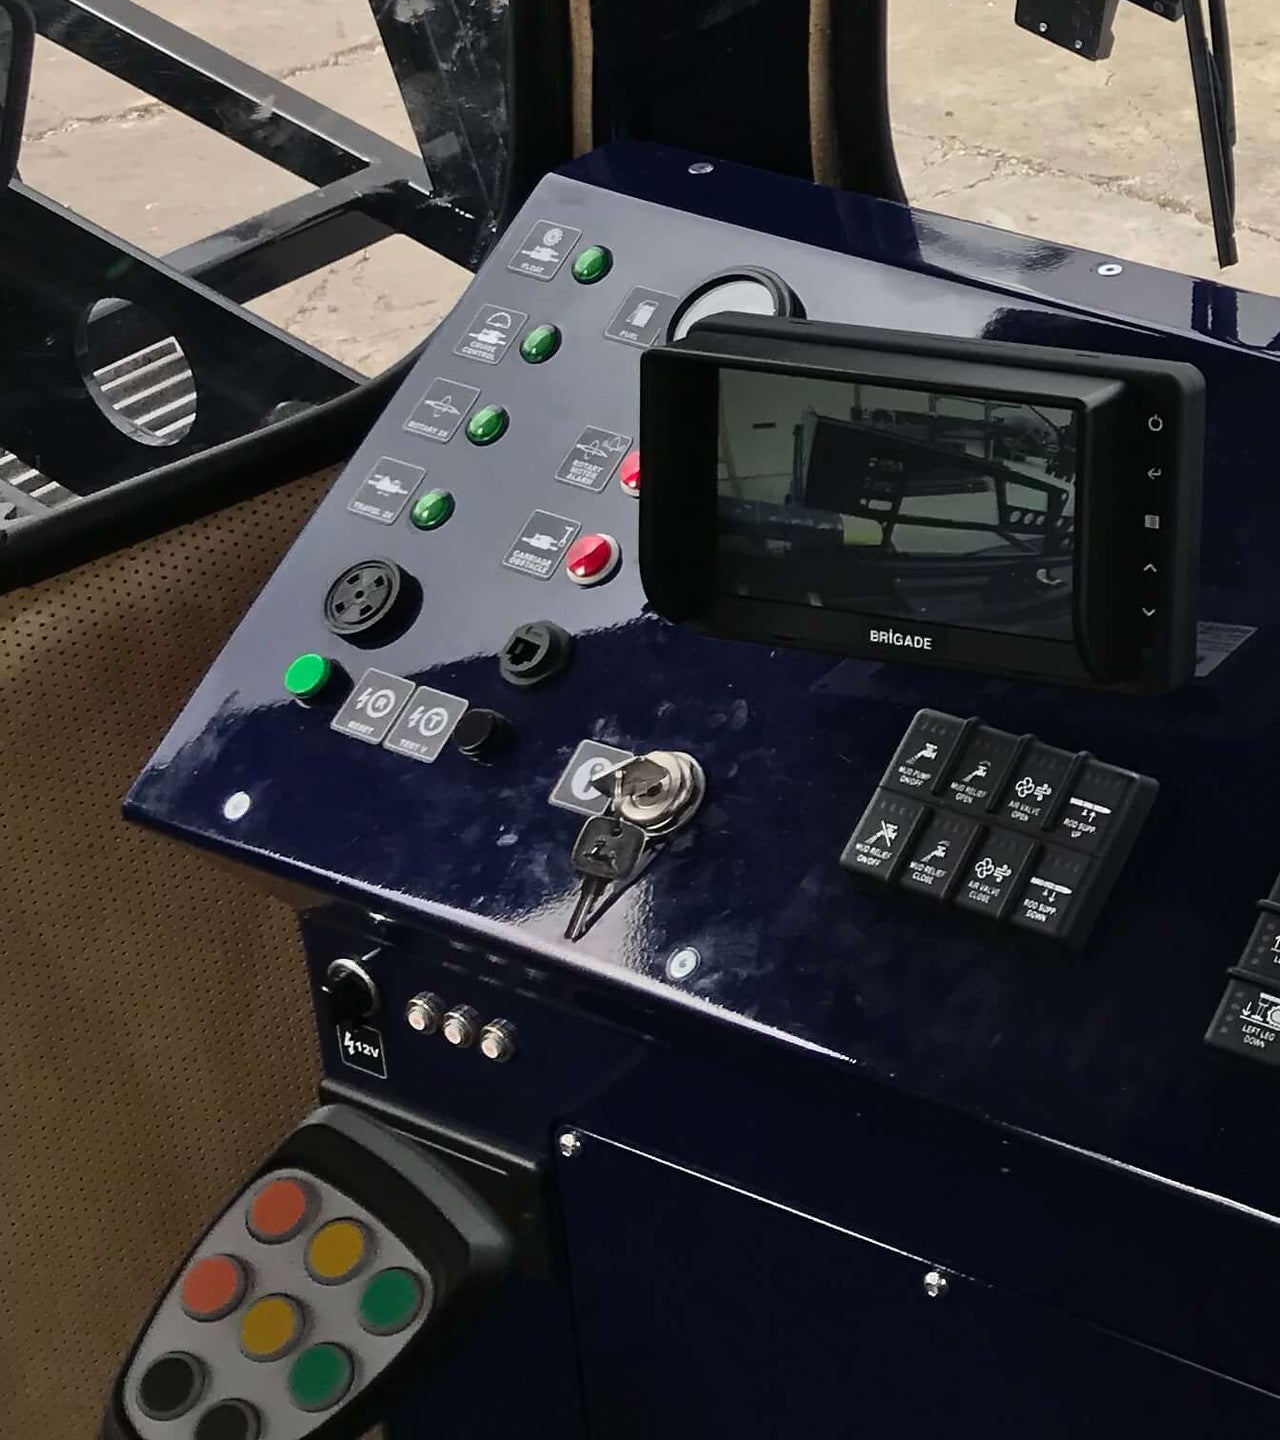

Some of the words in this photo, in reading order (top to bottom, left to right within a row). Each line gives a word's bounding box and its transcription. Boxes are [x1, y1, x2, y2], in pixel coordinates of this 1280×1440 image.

[461, 346, 496, 362] CONTROL
[1242, 1024, 1261, 1036] LEFT
[1260, 1030, 1277, 1042] LEG
[356, 1041, 380, 1059] 12V
[1243, 1035, 1266, 1049] DOWN
